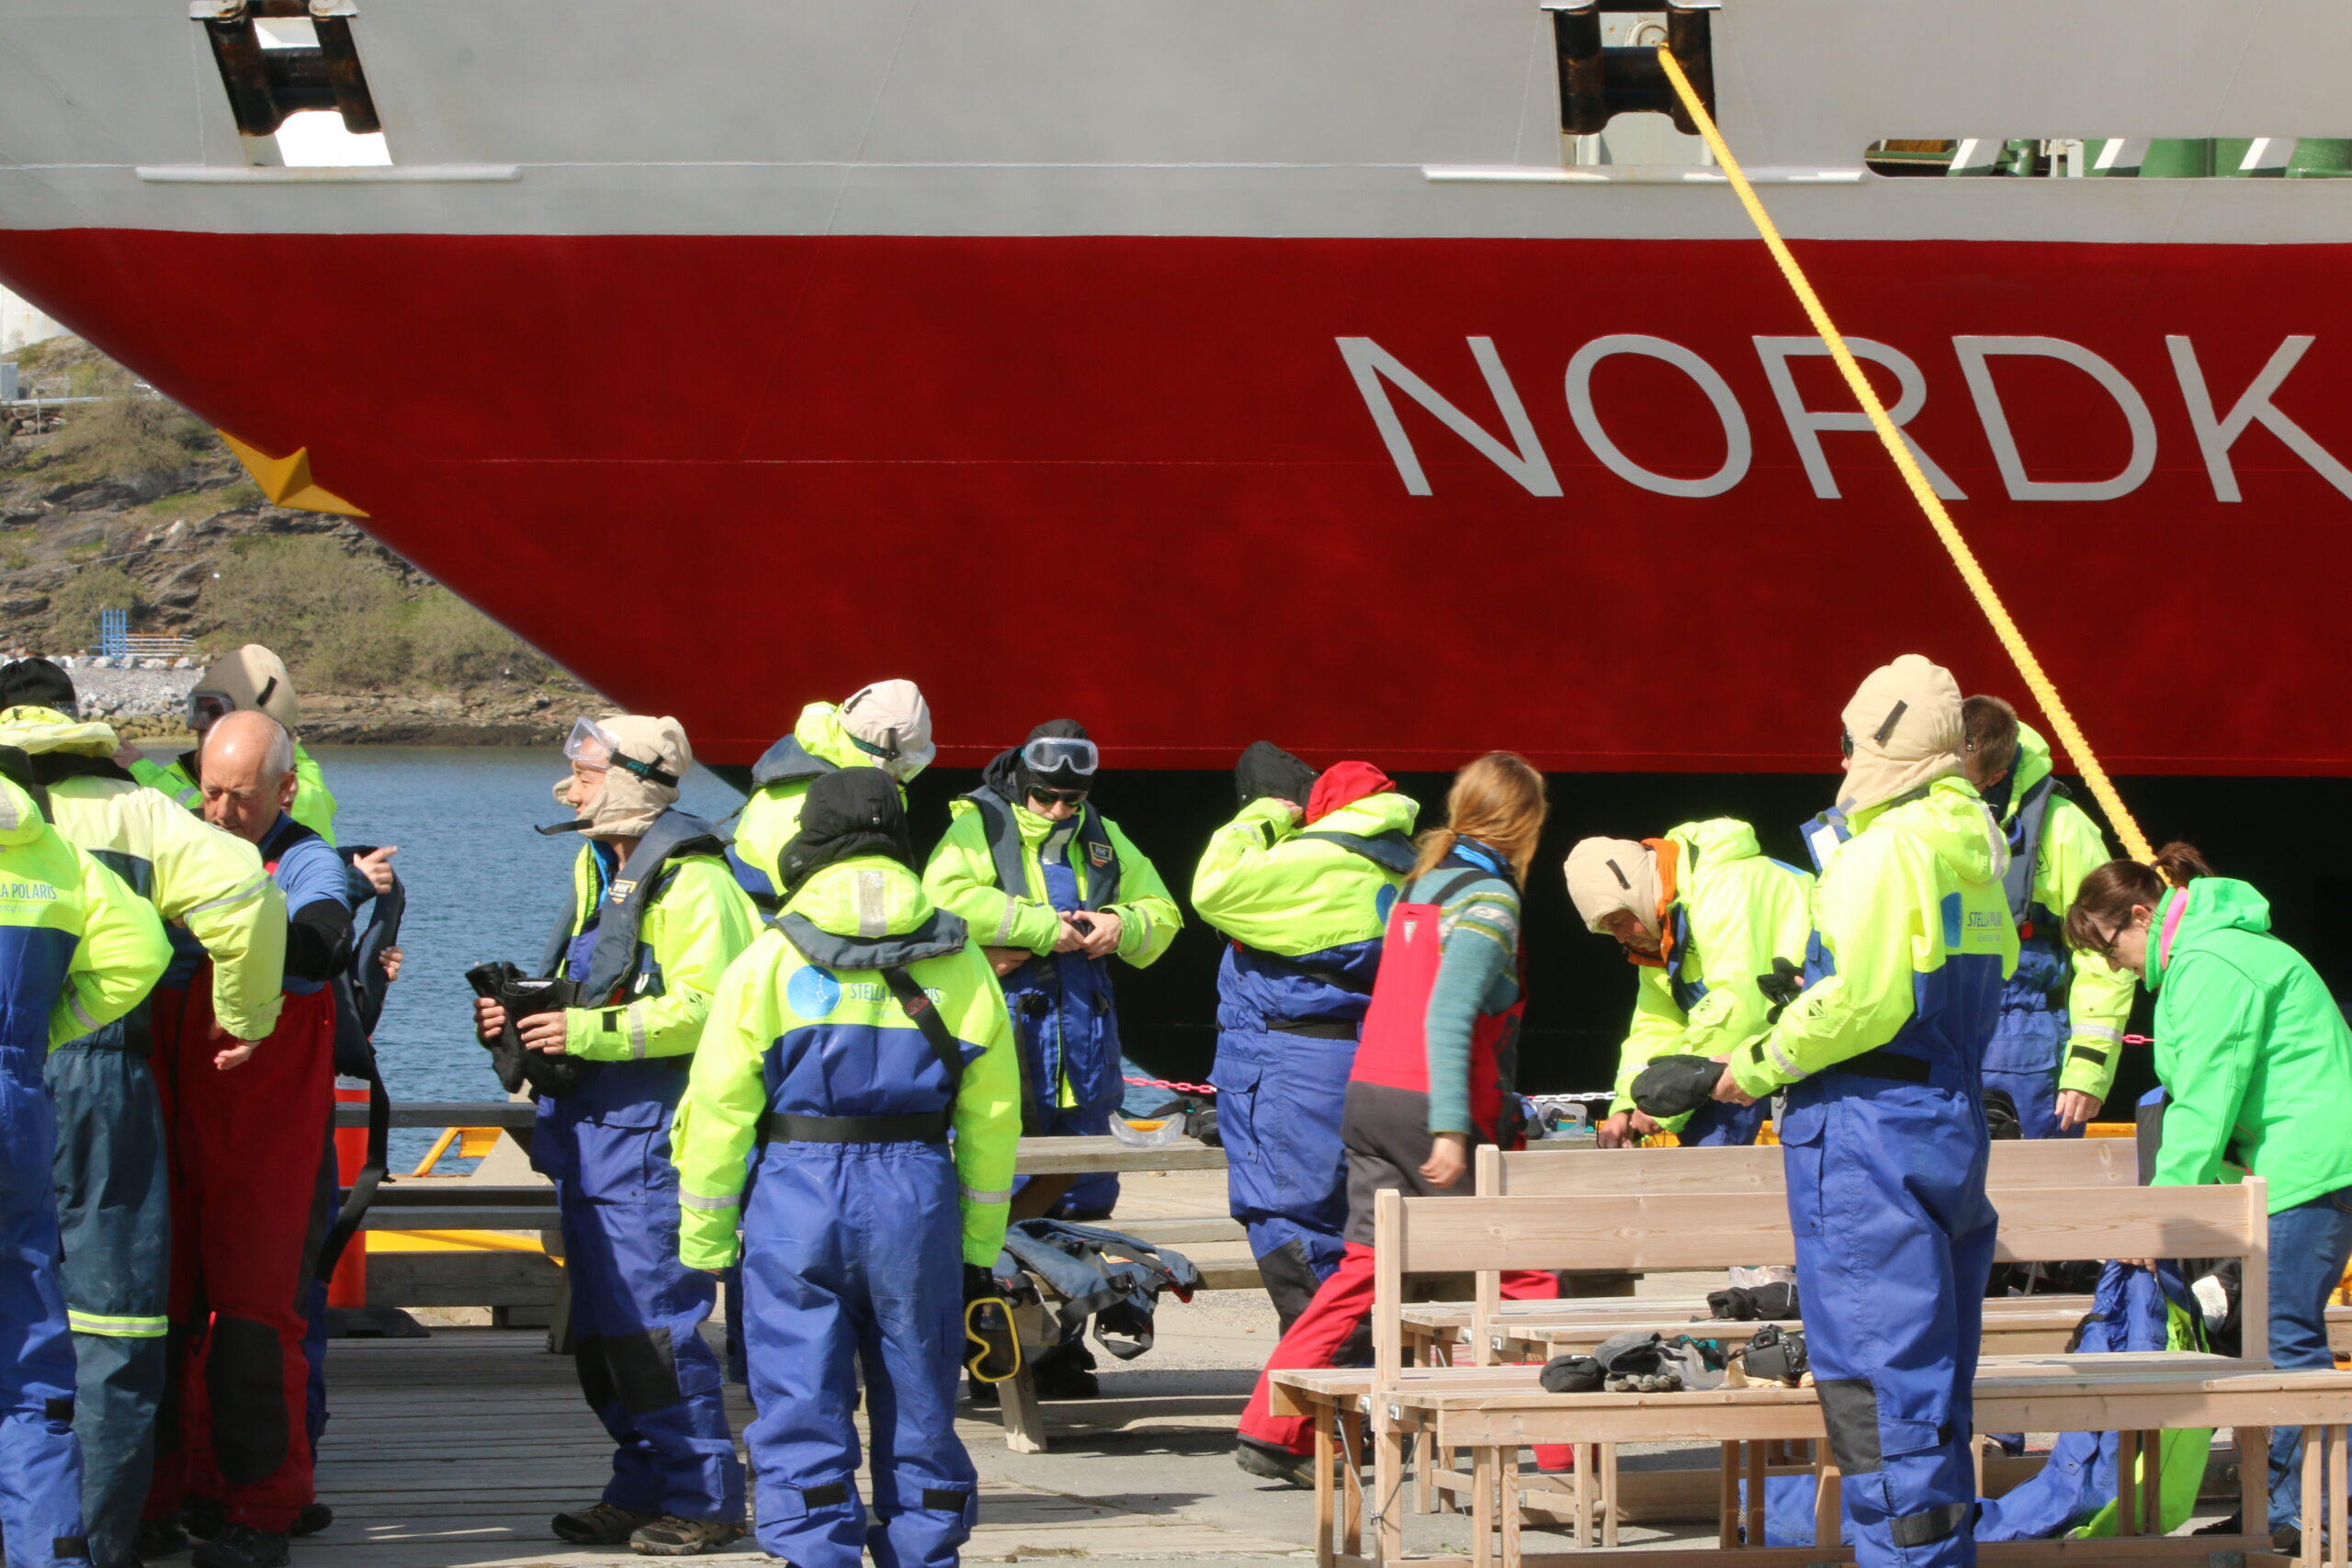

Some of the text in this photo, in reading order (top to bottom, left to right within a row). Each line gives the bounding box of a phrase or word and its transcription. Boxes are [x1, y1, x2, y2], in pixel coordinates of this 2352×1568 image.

[1335, 333, 2352, 503] NORDK
[12, 883, 57, 899] POLARIS
[850, 983, 886, 1002] STELLA
